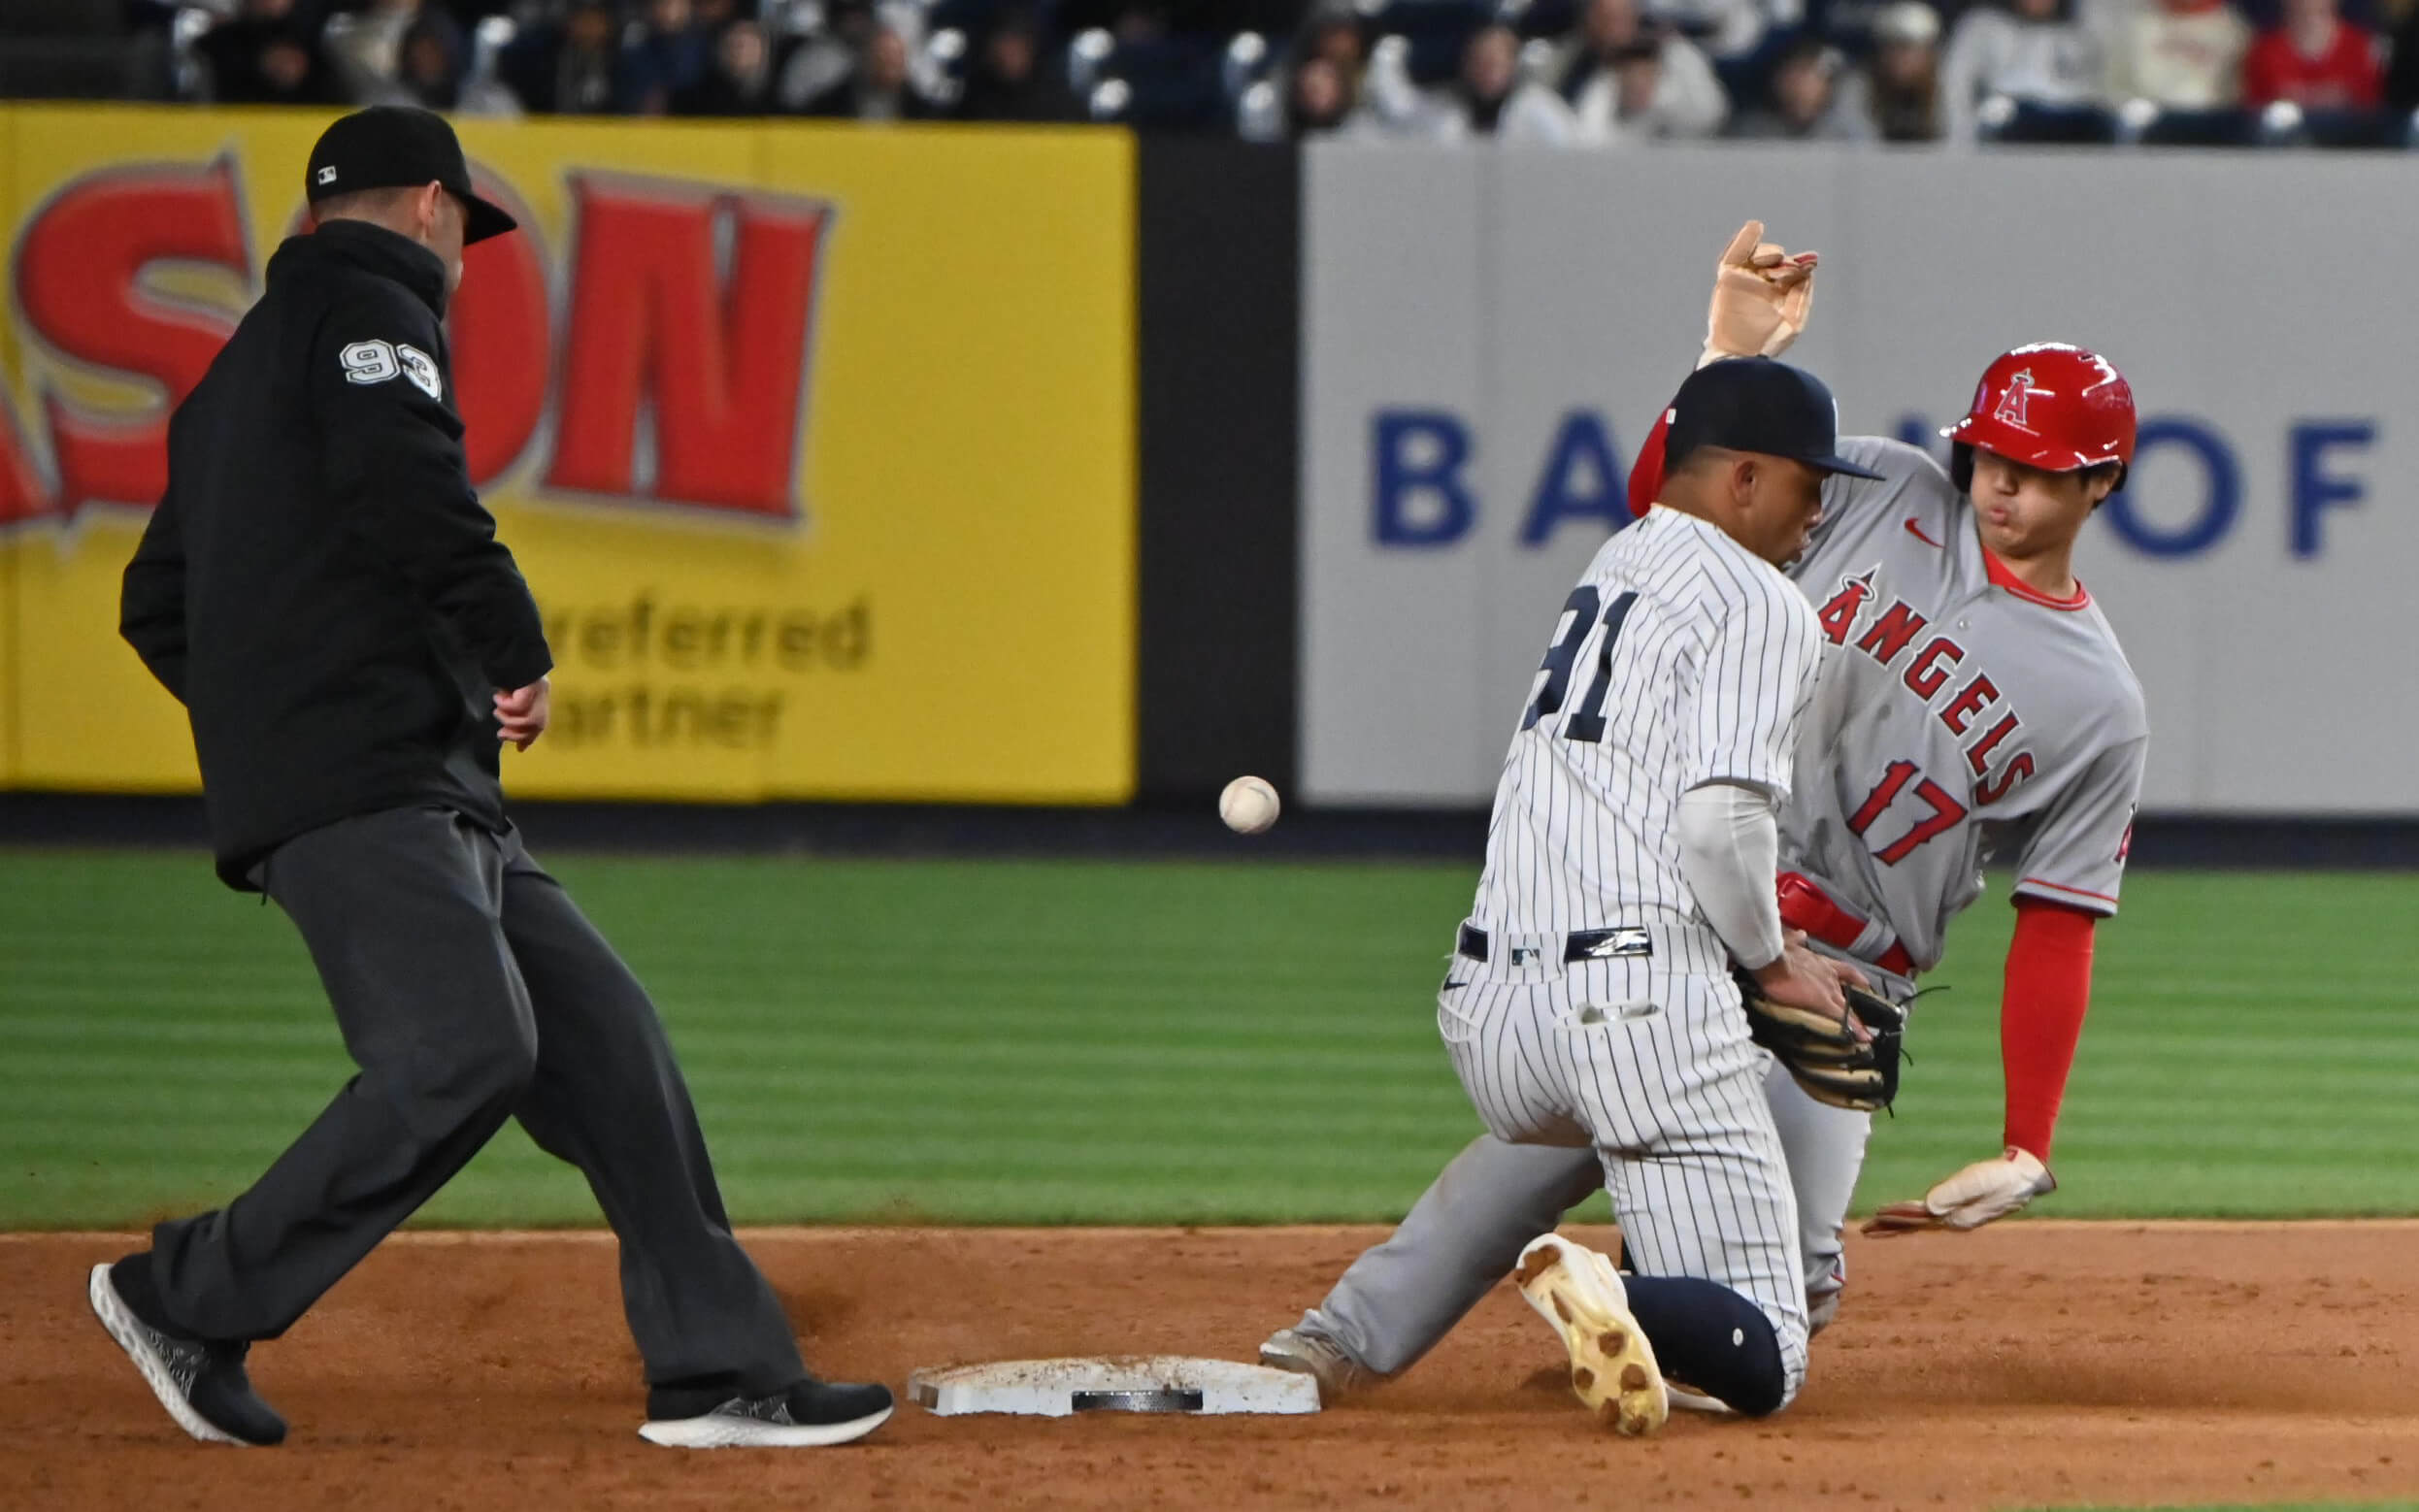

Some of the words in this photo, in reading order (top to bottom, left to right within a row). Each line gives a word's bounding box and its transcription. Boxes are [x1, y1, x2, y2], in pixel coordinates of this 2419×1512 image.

[339, 339, 442, 402] 93
[2104, 415, 2378, 559] OF
[546, 590, 872, 670] referred
[546, 684, 784, 749] artner
[1816, 563, 2037, 808] ANGELS
[1846, 759, 1969, 867] 17
